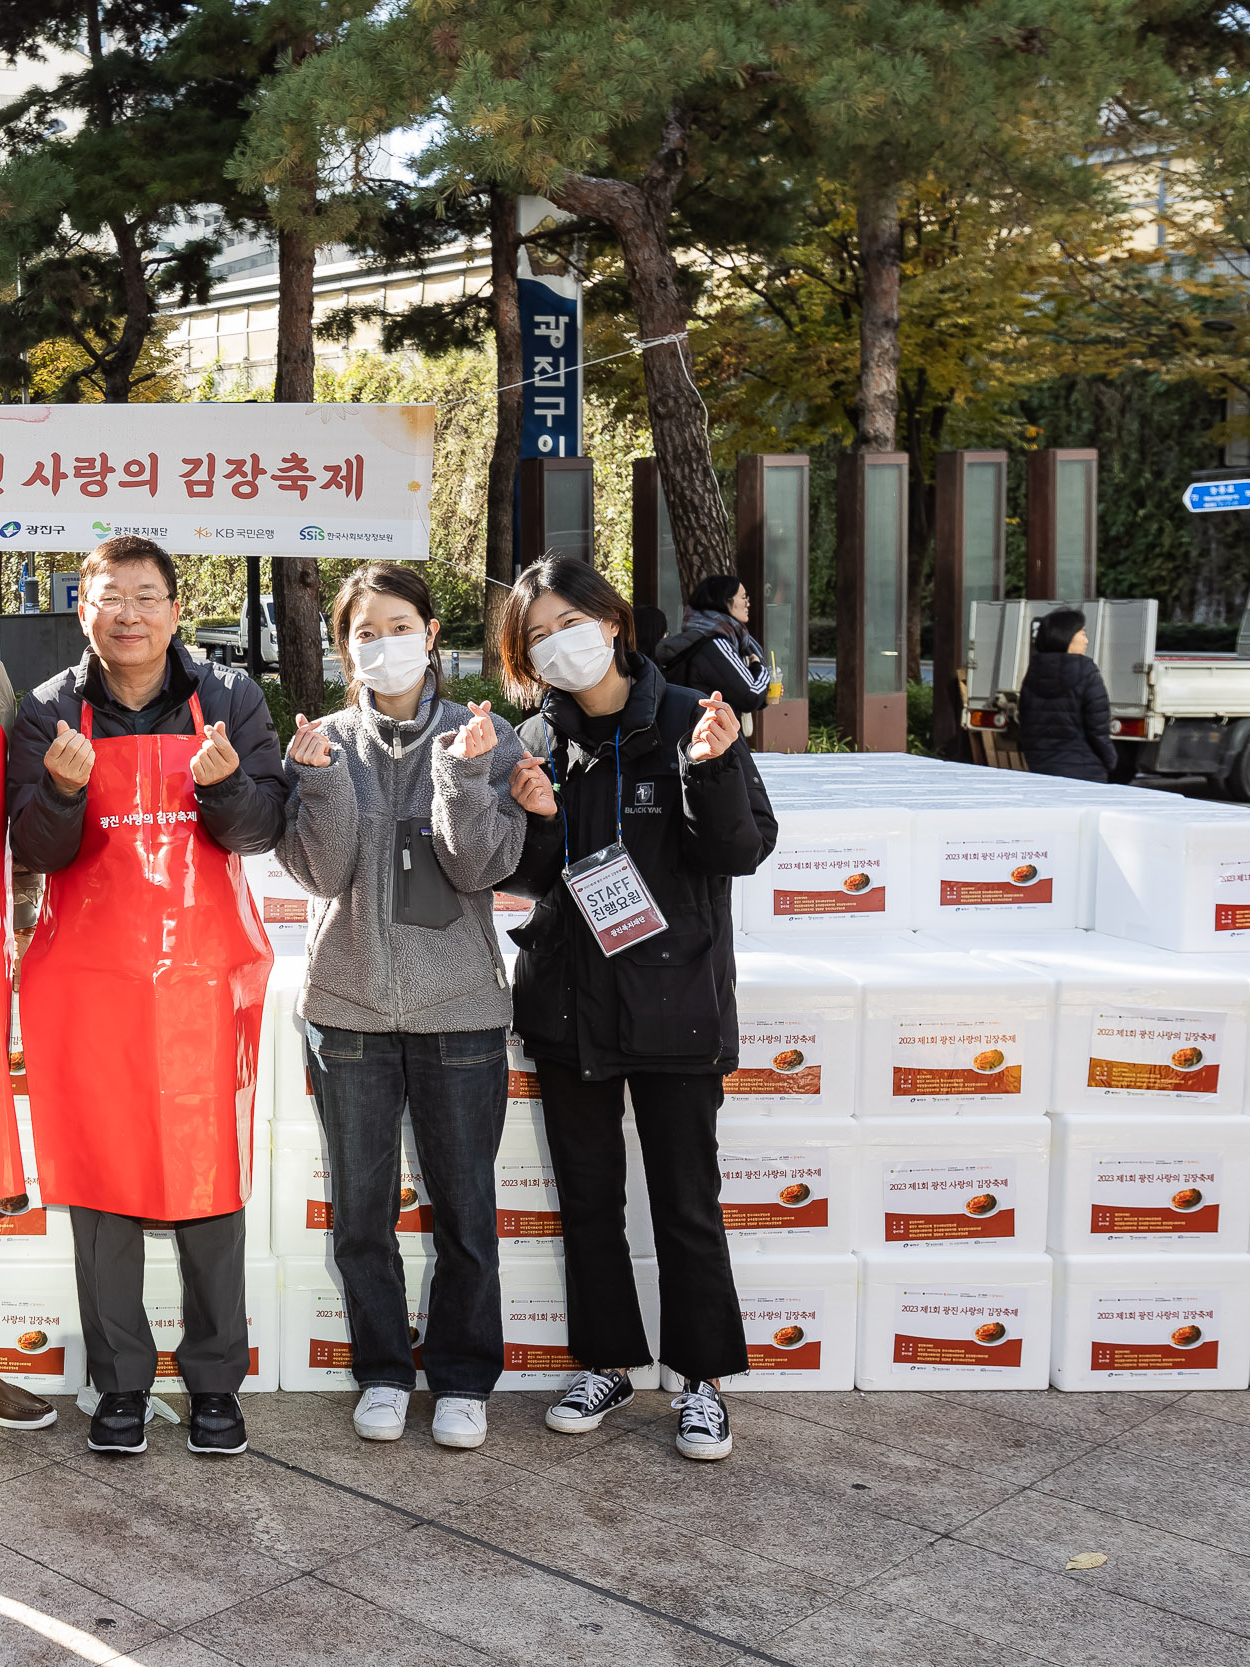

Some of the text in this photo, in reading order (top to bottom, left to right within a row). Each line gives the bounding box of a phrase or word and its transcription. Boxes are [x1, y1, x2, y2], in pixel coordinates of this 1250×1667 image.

[21, 451, 159, 498] 사랑의
[178, 452, 364, 501] 김장축제
[25, 525, 66, 536] 광진구
[113, 526, 168, 538] 광진복지재단
[327, 532, 393, 542] 한국사회보장정보원
[100, 810, 198, 829] 광진 사랑의 김장축제
[961, 852, 979, 860] 제1회
[981, 852, 995, 860] 광진
[996, 852, 1018, 860] 사랑의
[1020, 851, 1048, 860] 김장축제
[794, 862, 811, 870] 제1회
[814, 862, 827, 870] 광진
[829, 860, 850, 869] 사랑의
[852, 860, 880, 868] 김장축제
[587, 877, 631, 907] STAFF
[591, 890, 642, 921] 진행요원
[740, 1035, 816, 1044] 광진 사랑의 김장축제
[917, 1036, 937, 1045] 제1회
[940, 1035, 955, 1045] 광진
[958, 1035, 981, 1044] 사랑의
[984, 1034, 1016, 1044] 김장축제
[1097, 1028, 1216, 1042] 2023 제1회 광진 사랑의 김장축제
[520, 1178, 539, 1187] 제1회
[908, 1182, 928, 1190] 제1회
[931, 1181, 946, 1190] 광진
[949, 1180, 973, 1189] 사랑의
[976, 1178, 1008, 1188] 김장축제
[1116, 1174, 1136, 1182] 제1회
[1138, 1174, 1154, 1183] 광진
[1156, 1174, 1180, 1183] 사랑의
[1183, 1174, 1214, 1182] 김장축제
[920, 1306, 940, 1314] 제1회
[942, 1306, 958, 1315] 광진
[960, 1307, 984, 1316] 사랑의
[987, 1308, 1018, 1317] 김장축제
[1116, 1312, 1136, 1320] 제1회
[1138, 1311, 1154, 1320] 광진
[1156, 1311, 1179, 1320] 사랑의
[1182, 1310, 1213, 1319] 김장축제
[2, 1315, 59, 1325] 사랑의 김장축제
